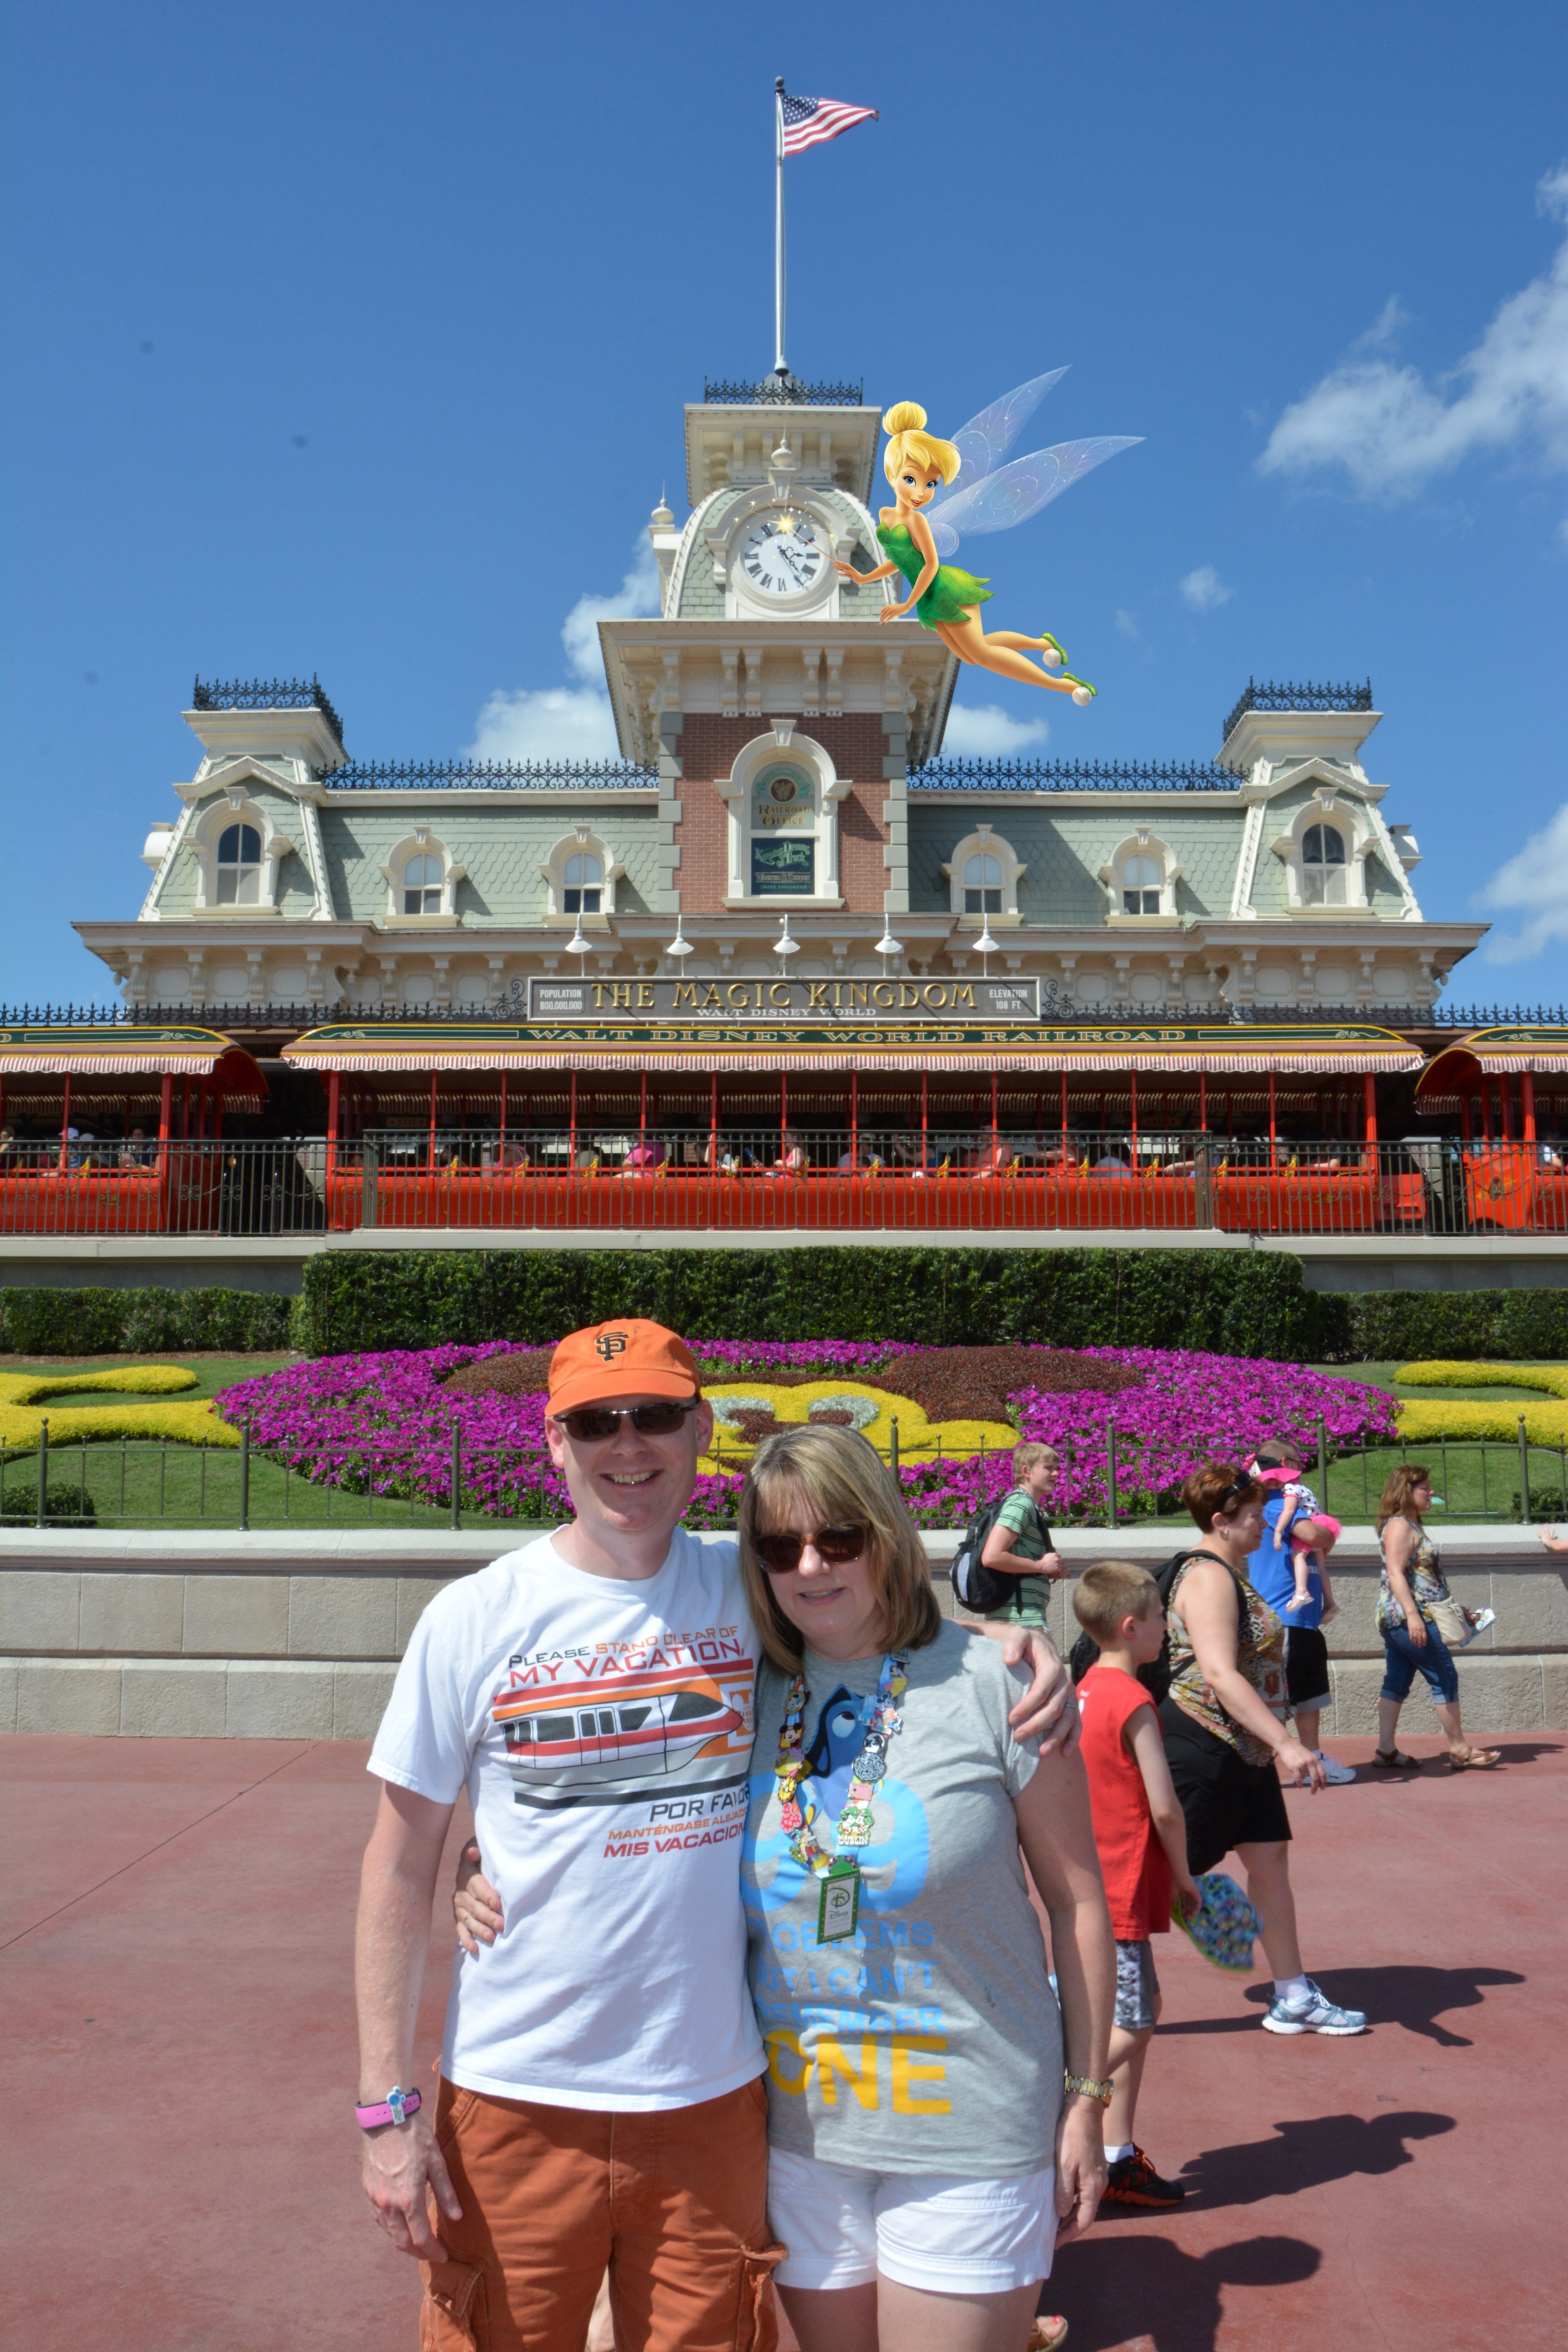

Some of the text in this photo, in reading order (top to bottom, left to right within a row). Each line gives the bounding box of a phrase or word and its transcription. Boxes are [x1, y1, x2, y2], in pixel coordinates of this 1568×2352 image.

[758, 804, 810, 814] RAILROAD
[762, 816, 804, 826] OFFICE
[539, 989, 582, 998] POPULATION
[592, 983, 978, 1008] THE MAGIC KINGDOM
[989, 989, 1028, 998] ELEVATION
[995, 1001, 1022, 1010] 108 FT.
[528, 1030, 1186, 1042] WALT DISNEY WORLD RAILROAD
[509, 1626, 738, 1668] PLEASE STAND CLEAR OF
[510, 1661, 564, 1688] MY
[649, 1799, 704, 1822] POR
[608, 1818, 710, 1840] MANTÉNGASE
[837, 1836, 869, 1845] DUBLIN
[603, 1841, 649, 1858] MIS
[828, 1910, 849, 1919] Disney
[808, 1969, 820, 1995] I
[828, 1960, 937, 1998] CAN'T
[756, 1995, 947, 2035] REMEMBER
[765, 2030, 951, 2114] ONE
